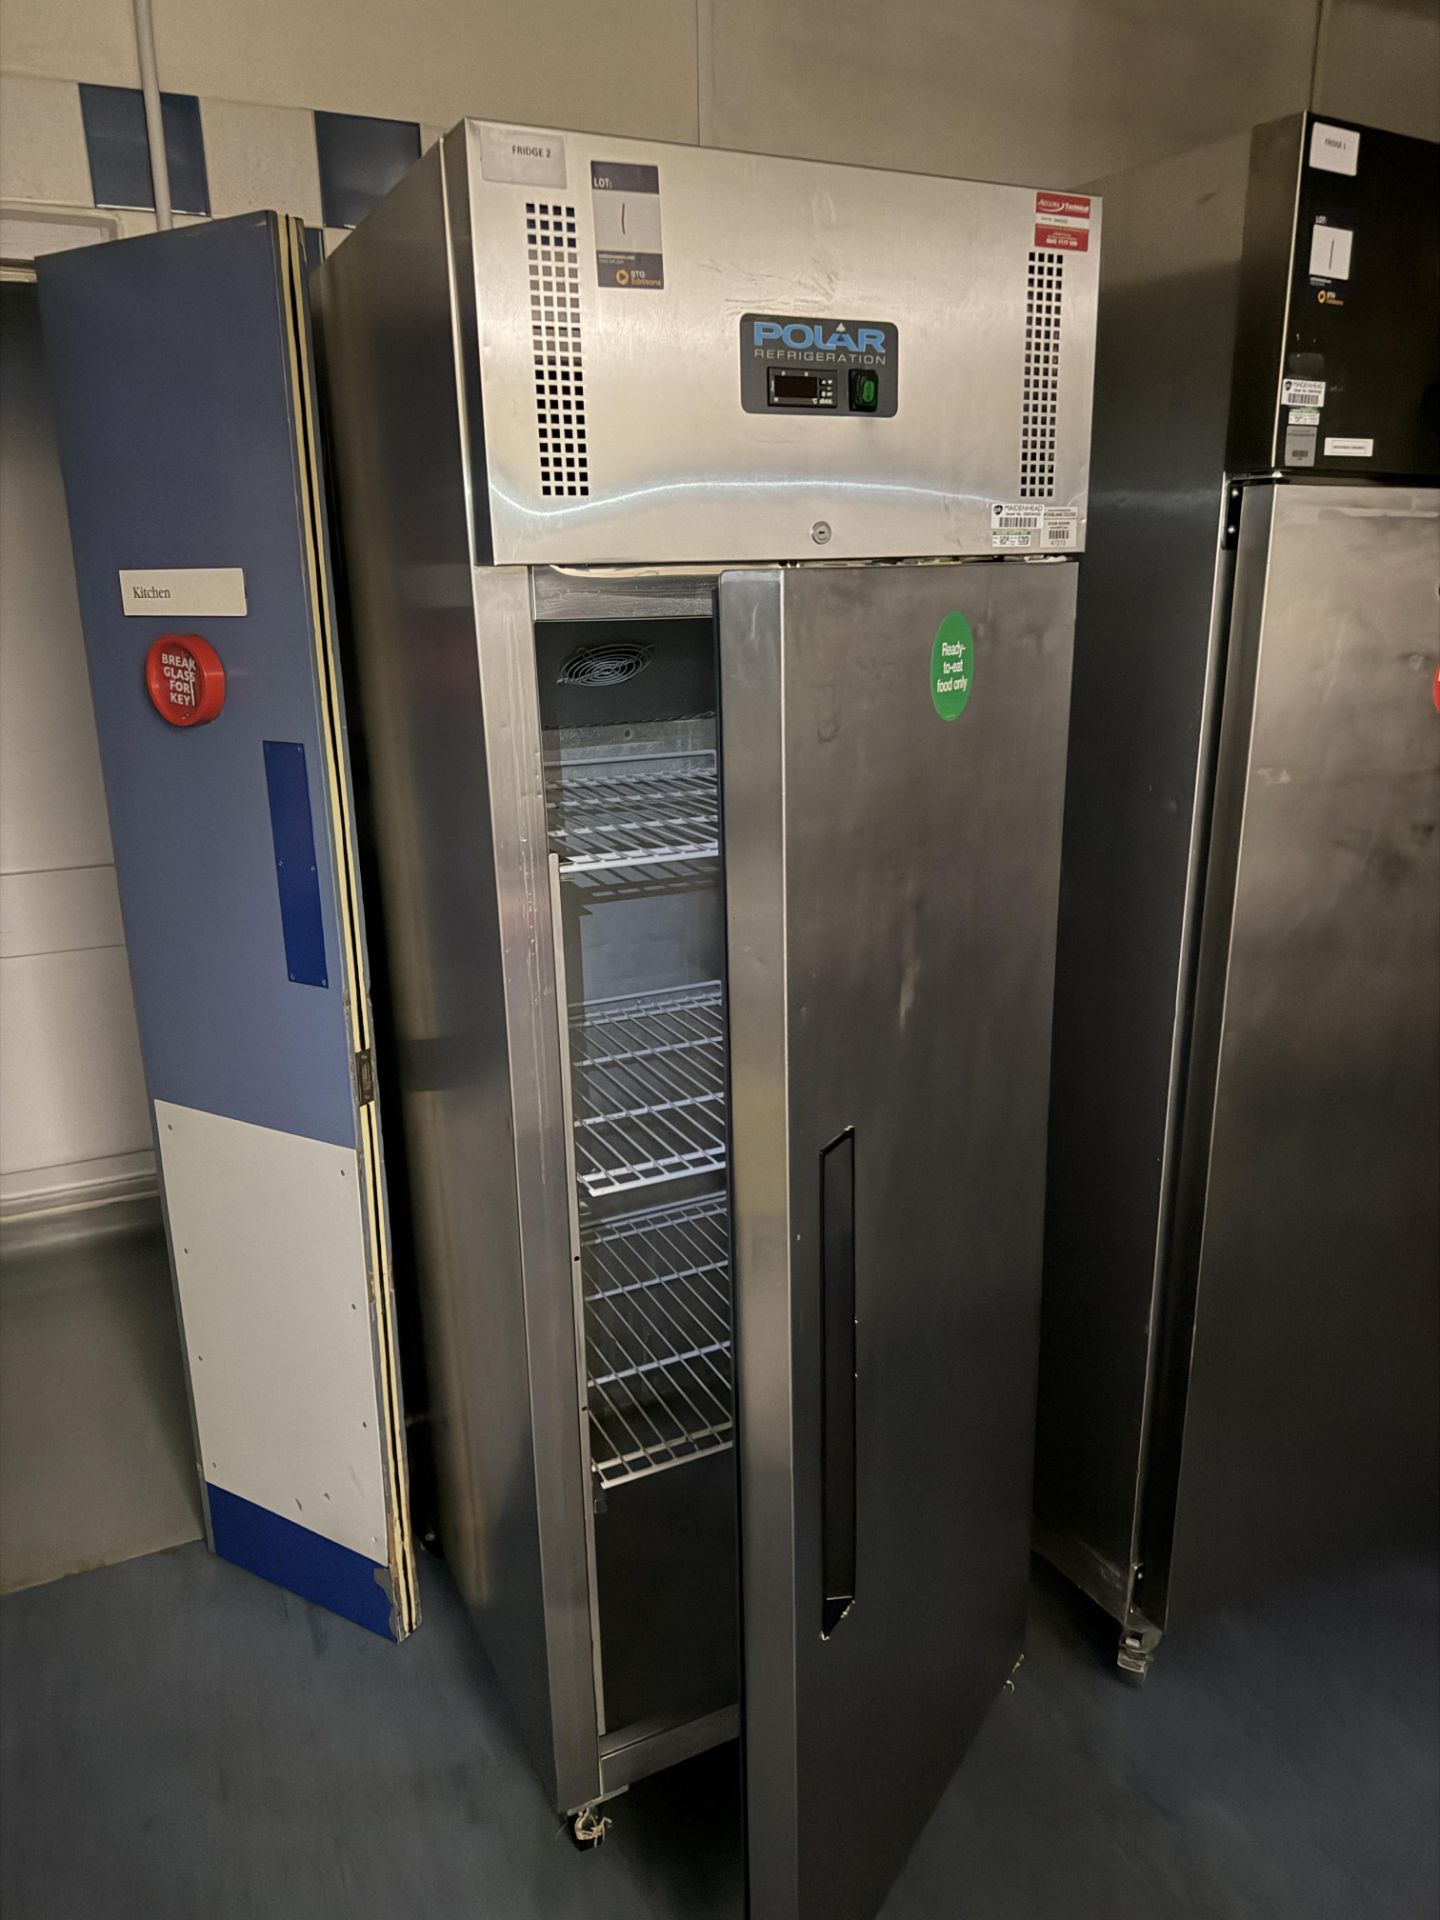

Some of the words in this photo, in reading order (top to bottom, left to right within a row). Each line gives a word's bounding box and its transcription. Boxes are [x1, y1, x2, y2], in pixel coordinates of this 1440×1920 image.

[512, 145, 544, 158] FRIDGE
[546, 148, 551, 159] 2
[754, 321, 886, 353] POLAR
[754, 349, 886, 365] REFRIGERATION
[132, 586, 171, 599] Kitchen
[942, 641, 966, 658] Ready-
[161, 653, 196, 671] BREAK
[943, 659, 963, 674] to-eat
[163, 666, 195, 682] GLASS
[169, 680, 191, 695] FOR
[937, 678, 953, 693] food
[953, 675, 968, 692] only
[170, 692, 191, 706] KEY
